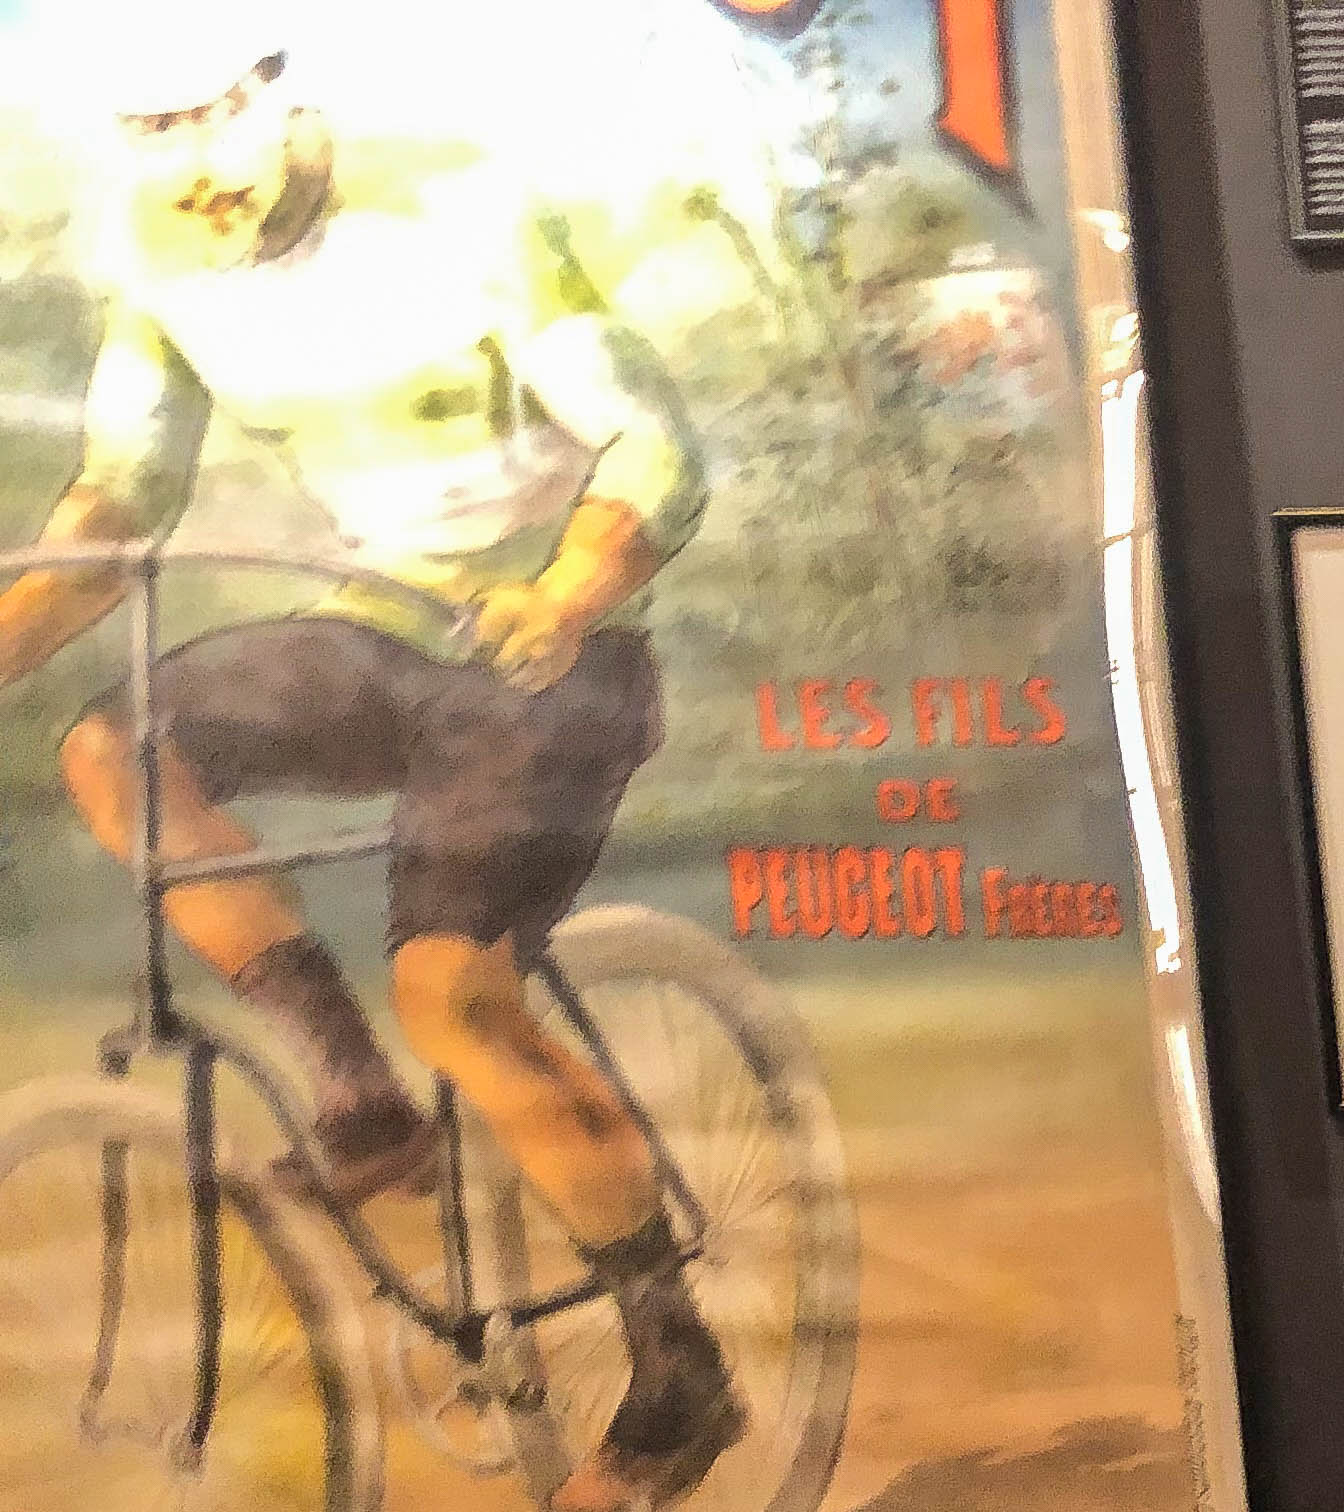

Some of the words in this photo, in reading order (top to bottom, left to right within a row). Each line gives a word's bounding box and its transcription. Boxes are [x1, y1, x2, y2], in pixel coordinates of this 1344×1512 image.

[756, 677, 892, 751] LES
[911, 675, 1068, 748] FILS
[876, 777, 961, 823] DE
[727, 845, 967, 939] PEUGEOT
